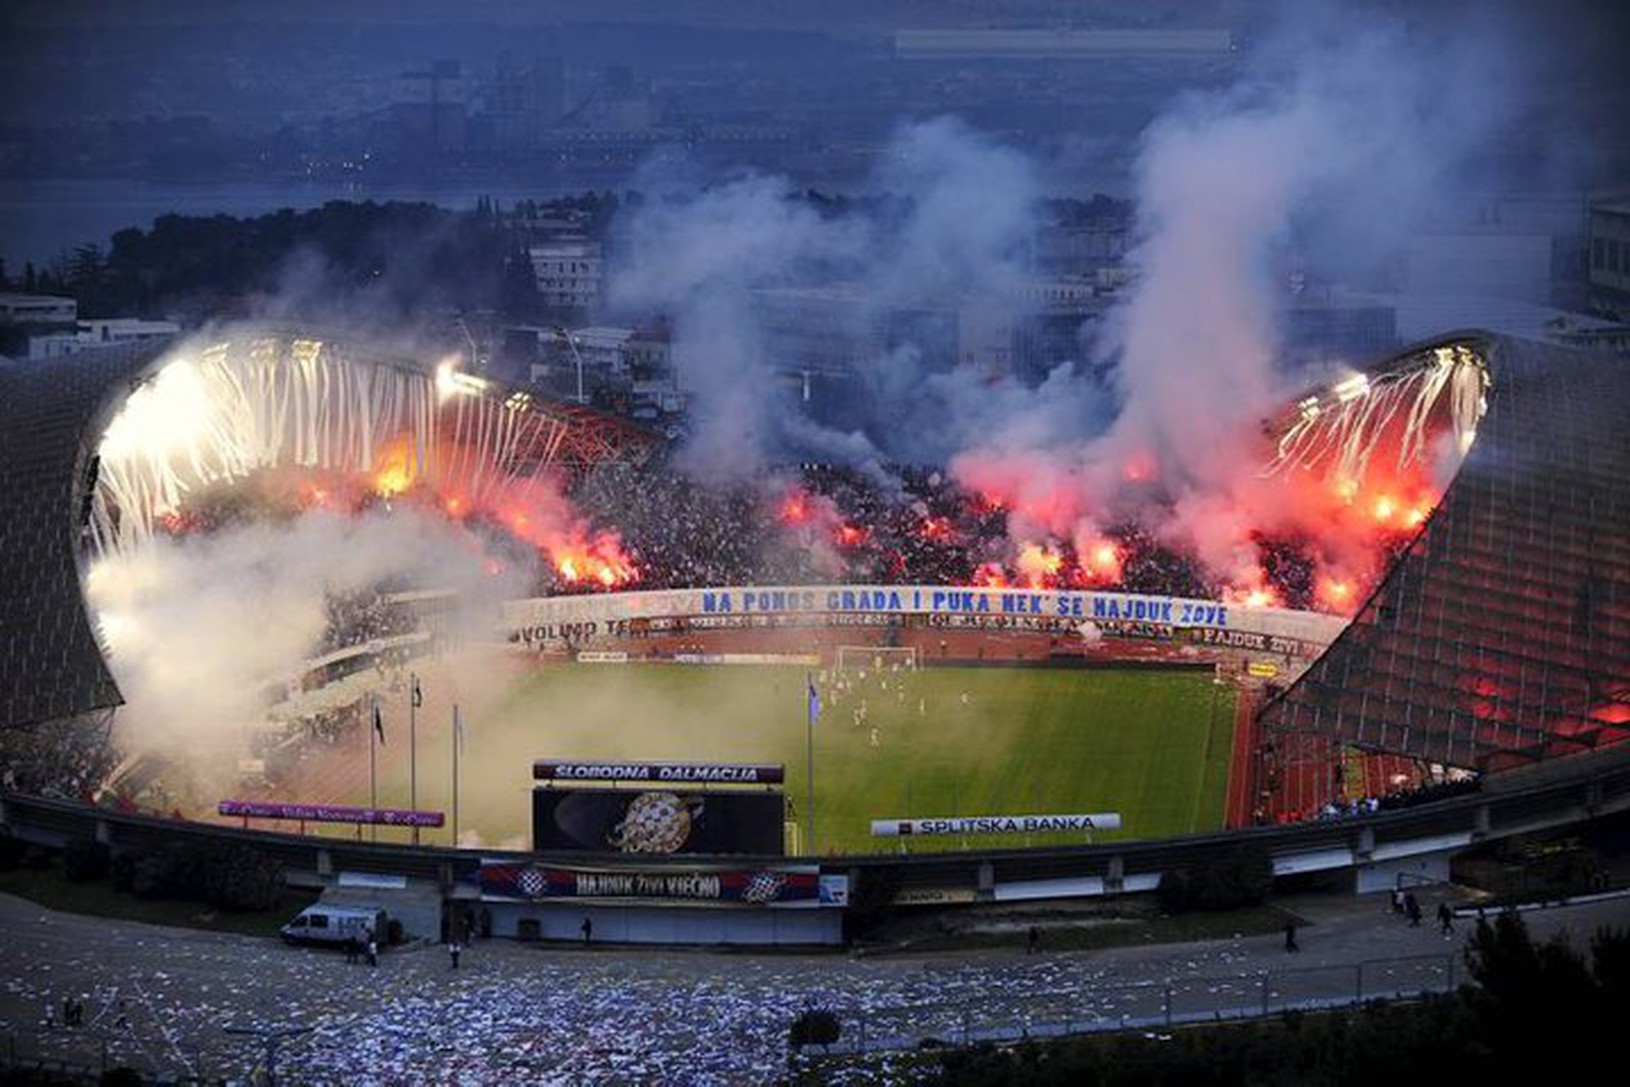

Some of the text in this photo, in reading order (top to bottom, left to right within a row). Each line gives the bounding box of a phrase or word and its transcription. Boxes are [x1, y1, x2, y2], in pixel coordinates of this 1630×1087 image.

[703, 591, 732, 613] NA
[743, 590, 816, 611] PONOS
[826, 590, 902, 610] GRADA
[913, 591, 921, 610] I
[932, 591, 990, 612] PUKA
[1057, 596, 1083, 616] SE
[555, 764, 758, 781] SLOBODNA DALMACIJA
[920, 815, 1095, 835] SPLITSKA BANKA
